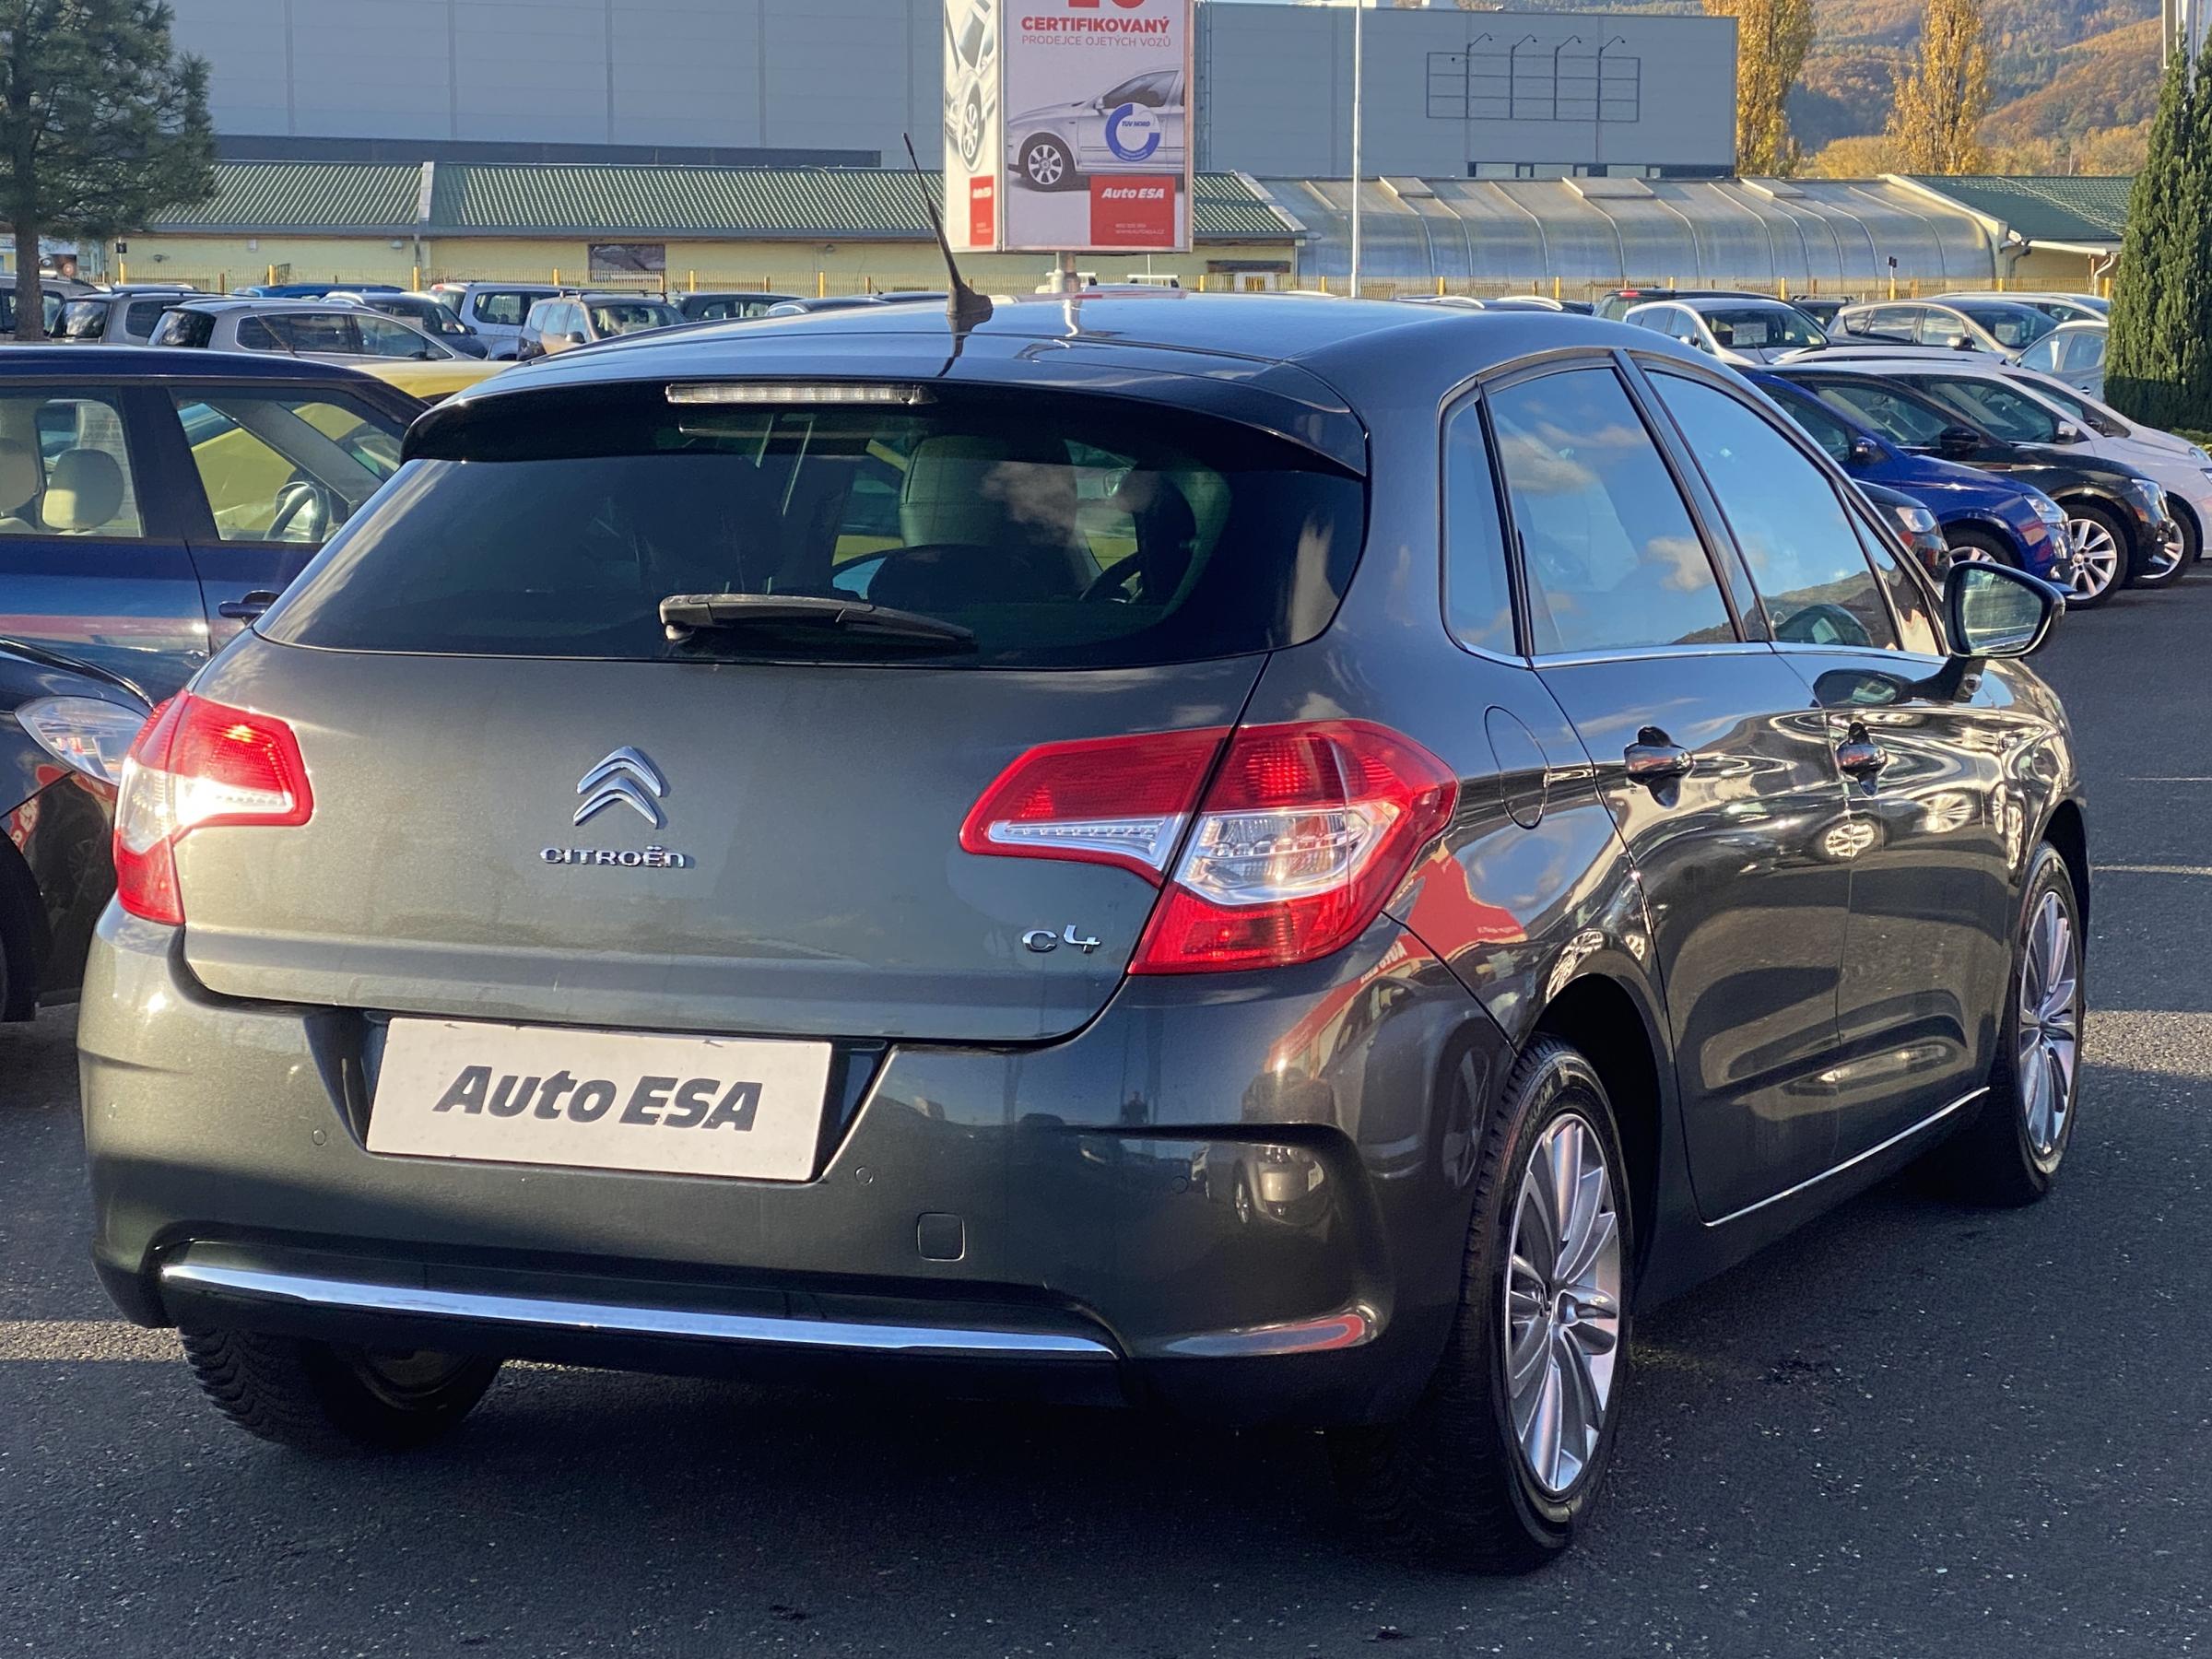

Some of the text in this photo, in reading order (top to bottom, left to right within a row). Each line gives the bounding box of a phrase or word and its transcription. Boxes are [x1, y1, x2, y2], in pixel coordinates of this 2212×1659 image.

[1021, 16, 1171, 34] CERTIFIKOVANÝ
[1021, 35, 1171, 48] PRODEJCE OJETÝCH VOZŮ
[1100, 187, 1165, 199] Auto ESA
[1021, 924, 1101, 954] C4
[431, 1065, 763, 1133] Auto ESA
